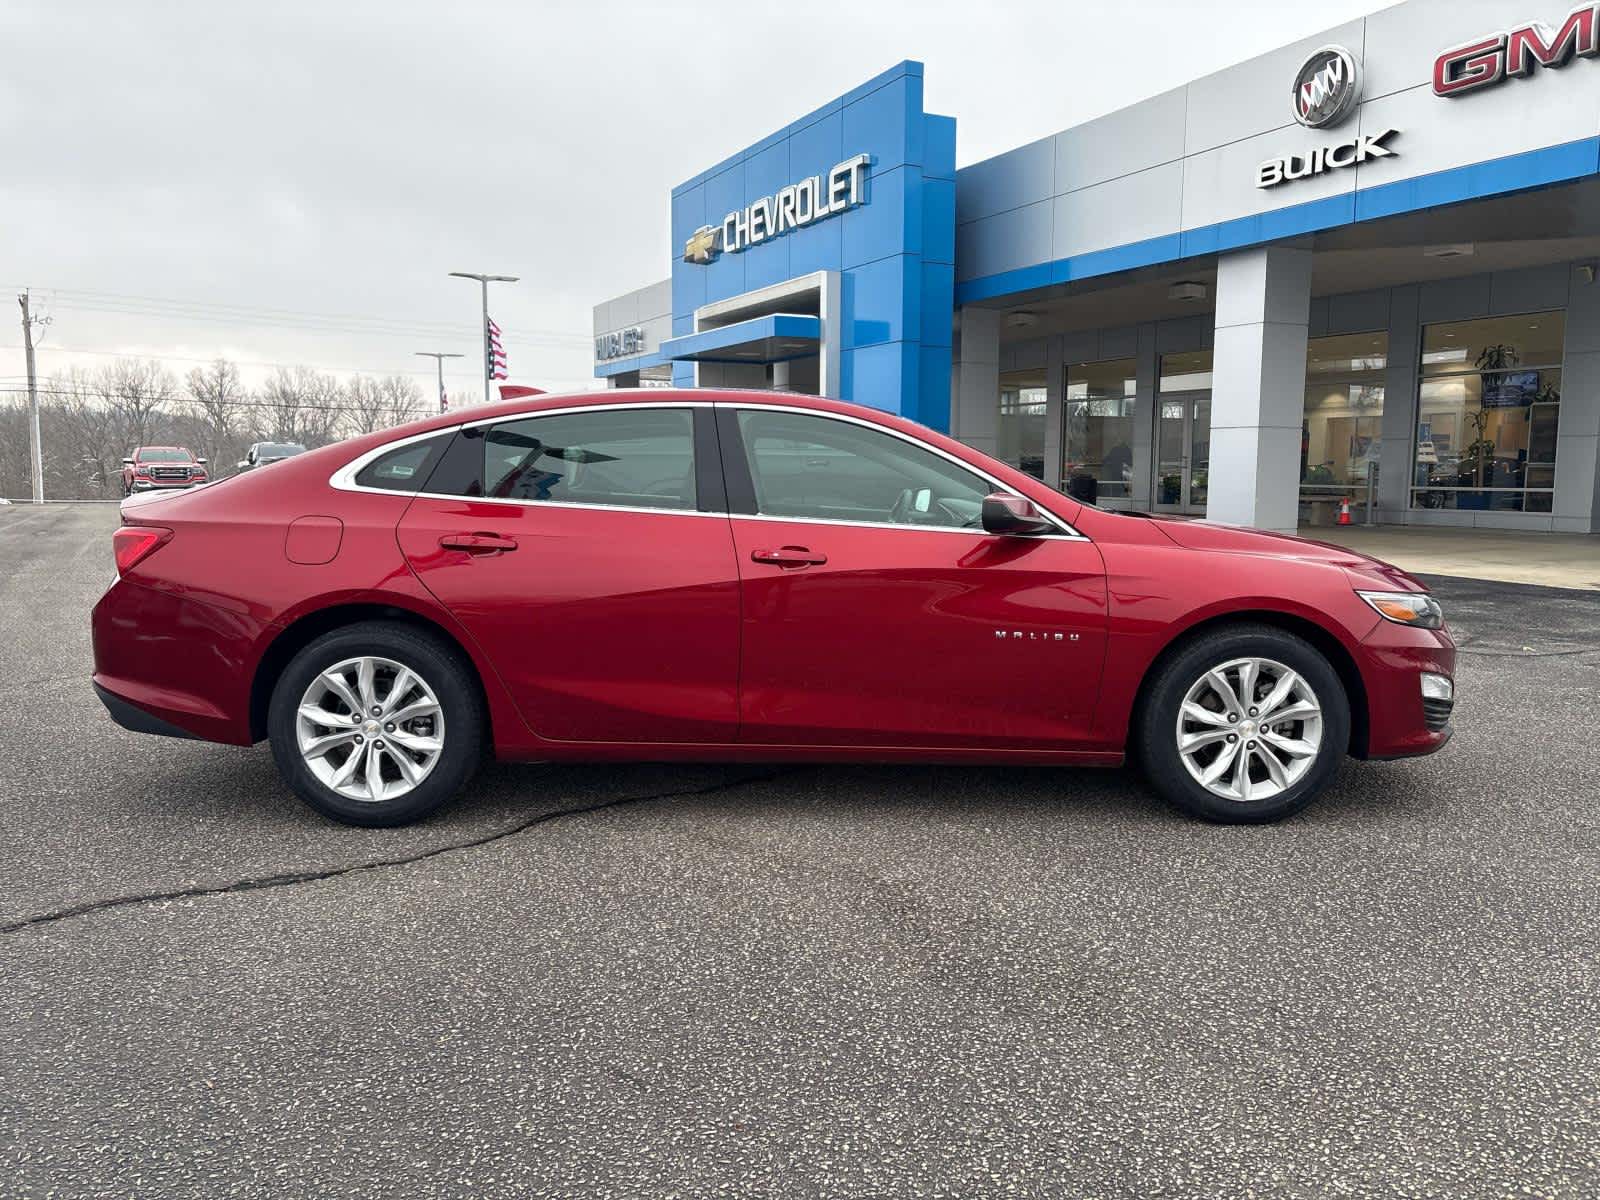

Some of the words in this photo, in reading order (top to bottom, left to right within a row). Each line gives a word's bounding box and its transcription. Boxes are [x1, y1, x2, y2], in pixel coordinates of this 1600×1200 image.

[1256, 129, 1399, 189] BUICK
[722, 154, 871, 253] CHEVROLET
[995, 630, 1080, 641] MALIBU
